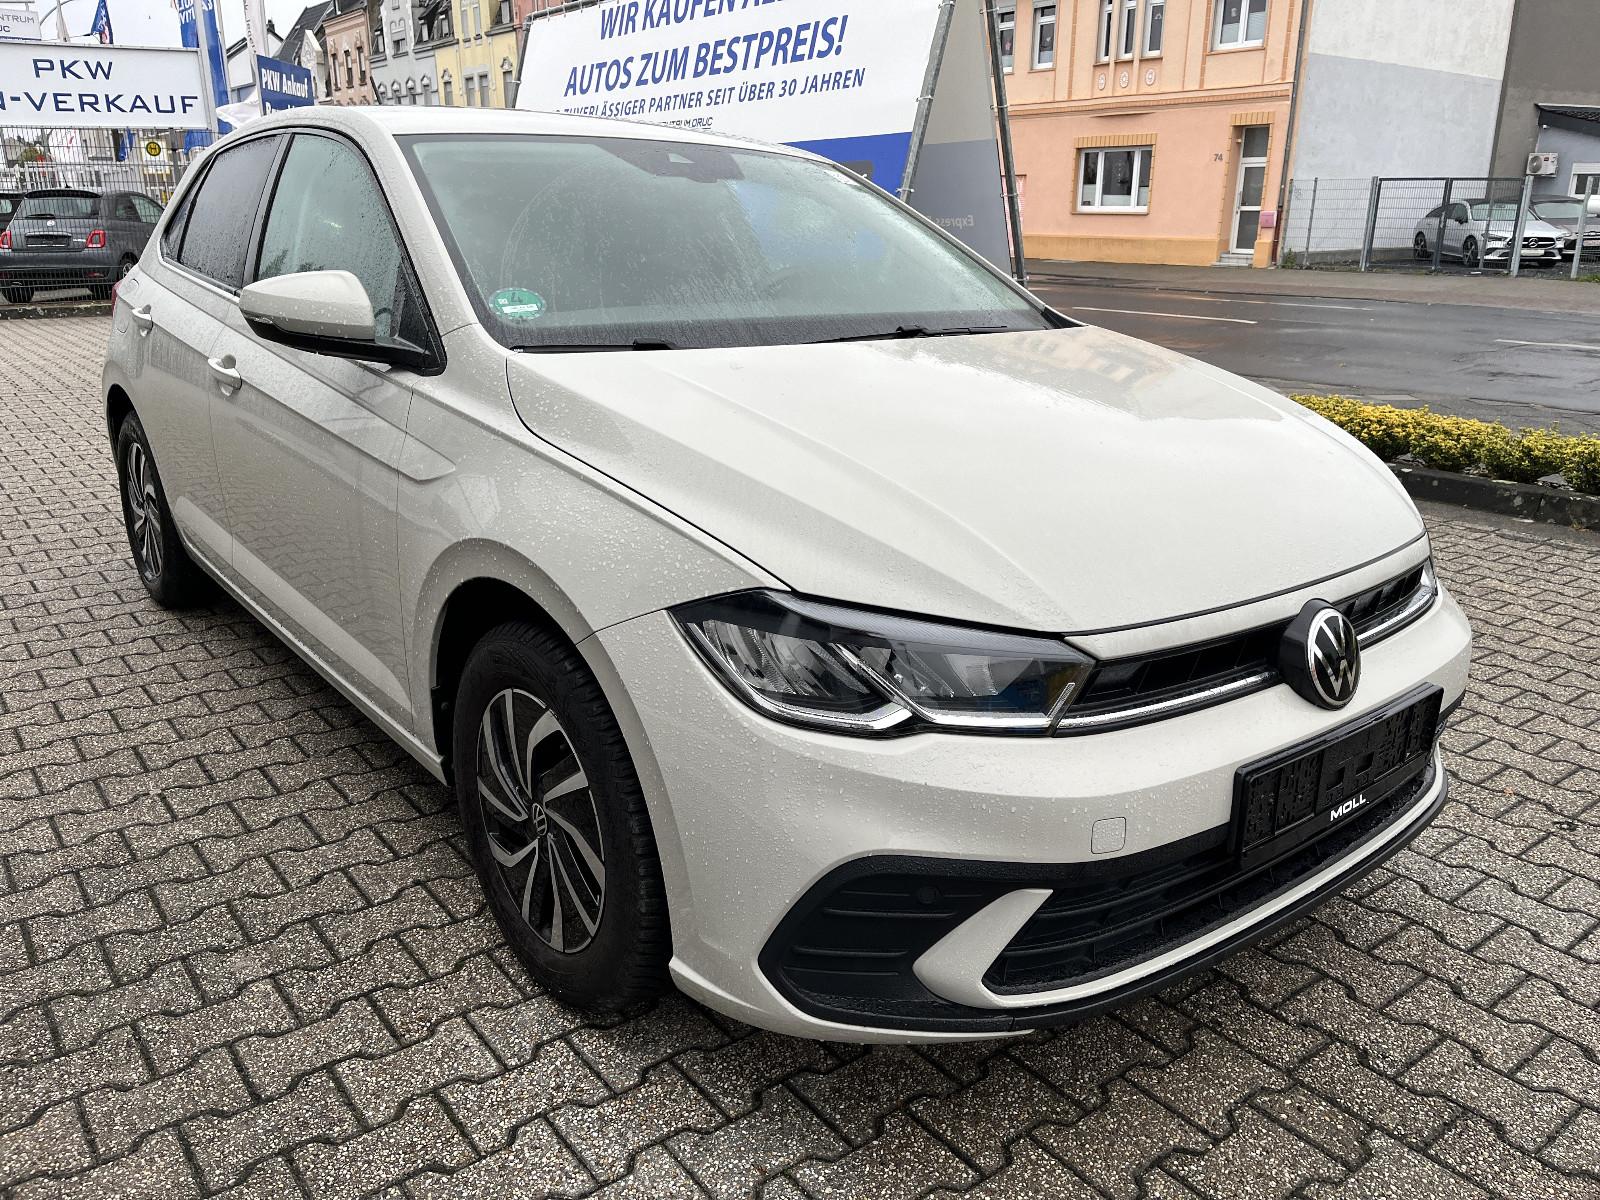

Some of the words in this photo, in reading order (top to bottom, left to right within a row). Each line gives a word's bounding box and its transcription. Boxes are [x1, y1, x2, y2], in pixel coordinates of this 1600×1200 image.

[600, 1, 640, 40] WIR
[32, 58, 113, 80] PKW
[563, 57, 633, 97] AUTOS
[635, 45, 690, 87] ZUM
[692, 14, 849, 79] BESTPREIS!
[261, 68, 281, 92] PKW
[282, 73, 309, 99] Ankauf
[564, 99, 646, 118] ERLÄSSIGER
[648, 91, 704, 113] PARTNER
[705, 86, 737, 107] SEIT
[738, 81, 776, 103] ÜBER
[778, 78, 798, 98] 30
[800, 67, 866, 95] JAHREN
[1213, 153, 1224, 162] 74
[1330, 793, 1367, 822] MOLL
